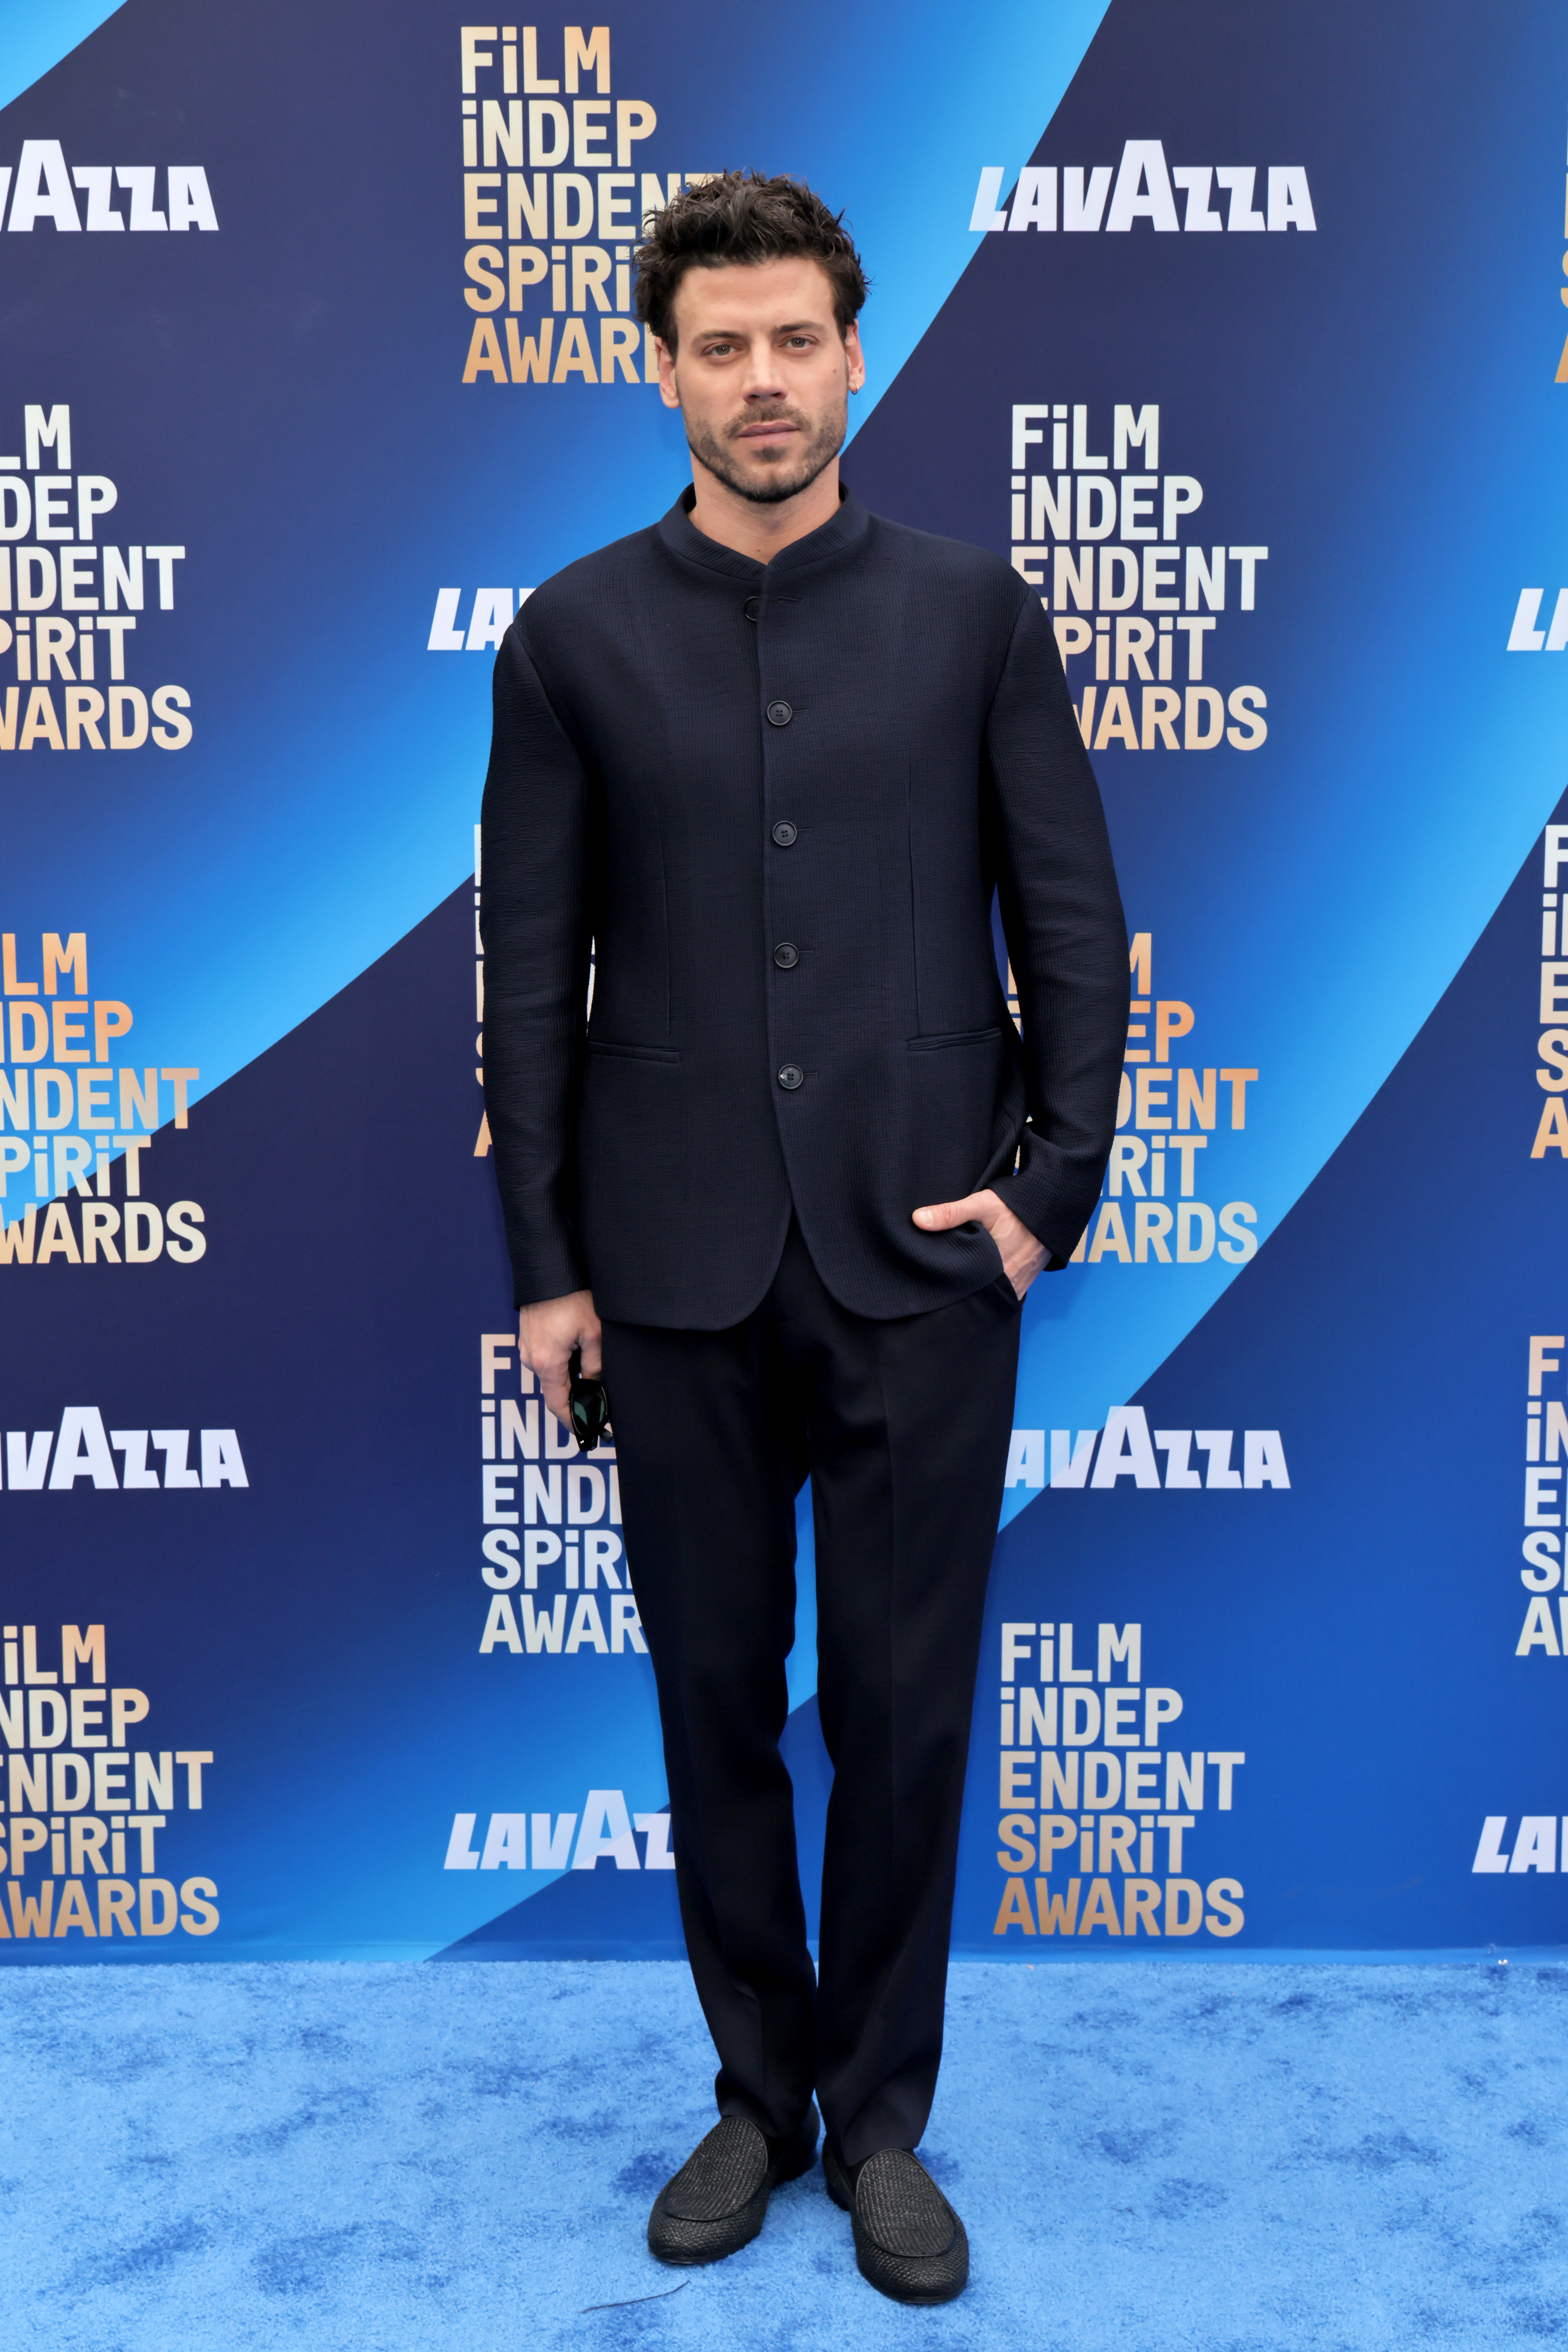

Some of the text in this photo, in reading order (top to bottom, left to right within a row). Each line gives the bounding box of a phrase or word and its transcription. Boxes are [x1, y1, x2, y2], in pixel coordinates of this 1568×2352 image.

[461, 27, 610, 94] FiLM
[462, 100, 657, 167] iNDEP
[0, 140, 219, 231] AZZA
[969, 140, 1316, 231] LAVAZZA
[464, 245, 639, 312] SPiRi
[1012, 405, 1159, 469] FiLM
[1012, 476, 1203, 540] iNDEP
[1011, 547, 1268, 610] ENDENT
[0, 1001, 133, 1063] DEP
[1102, 1136, 1207, 1196] RiT
[1070, 1201, 1258, 1263] ARDS
[0, 1407, 249, 1490] VAZZA
[482, 1529, 633, 1589] SPiR
[480, 1595, 649, 1653] AWAR
[1001, 1623, 1141, 1682] FiLM
[1000, 1687, 1182, 1746] iNDEP
[0, 1751, 213, 1812] NDENT
[1000, 1751, 1245, 1810] ENDENT
[0, 1815, 166, 1875] PiRiT
[998, 1814, 1195, 1873] SPiRiT
[994, 1878, 1244, 1937] AWARDS
